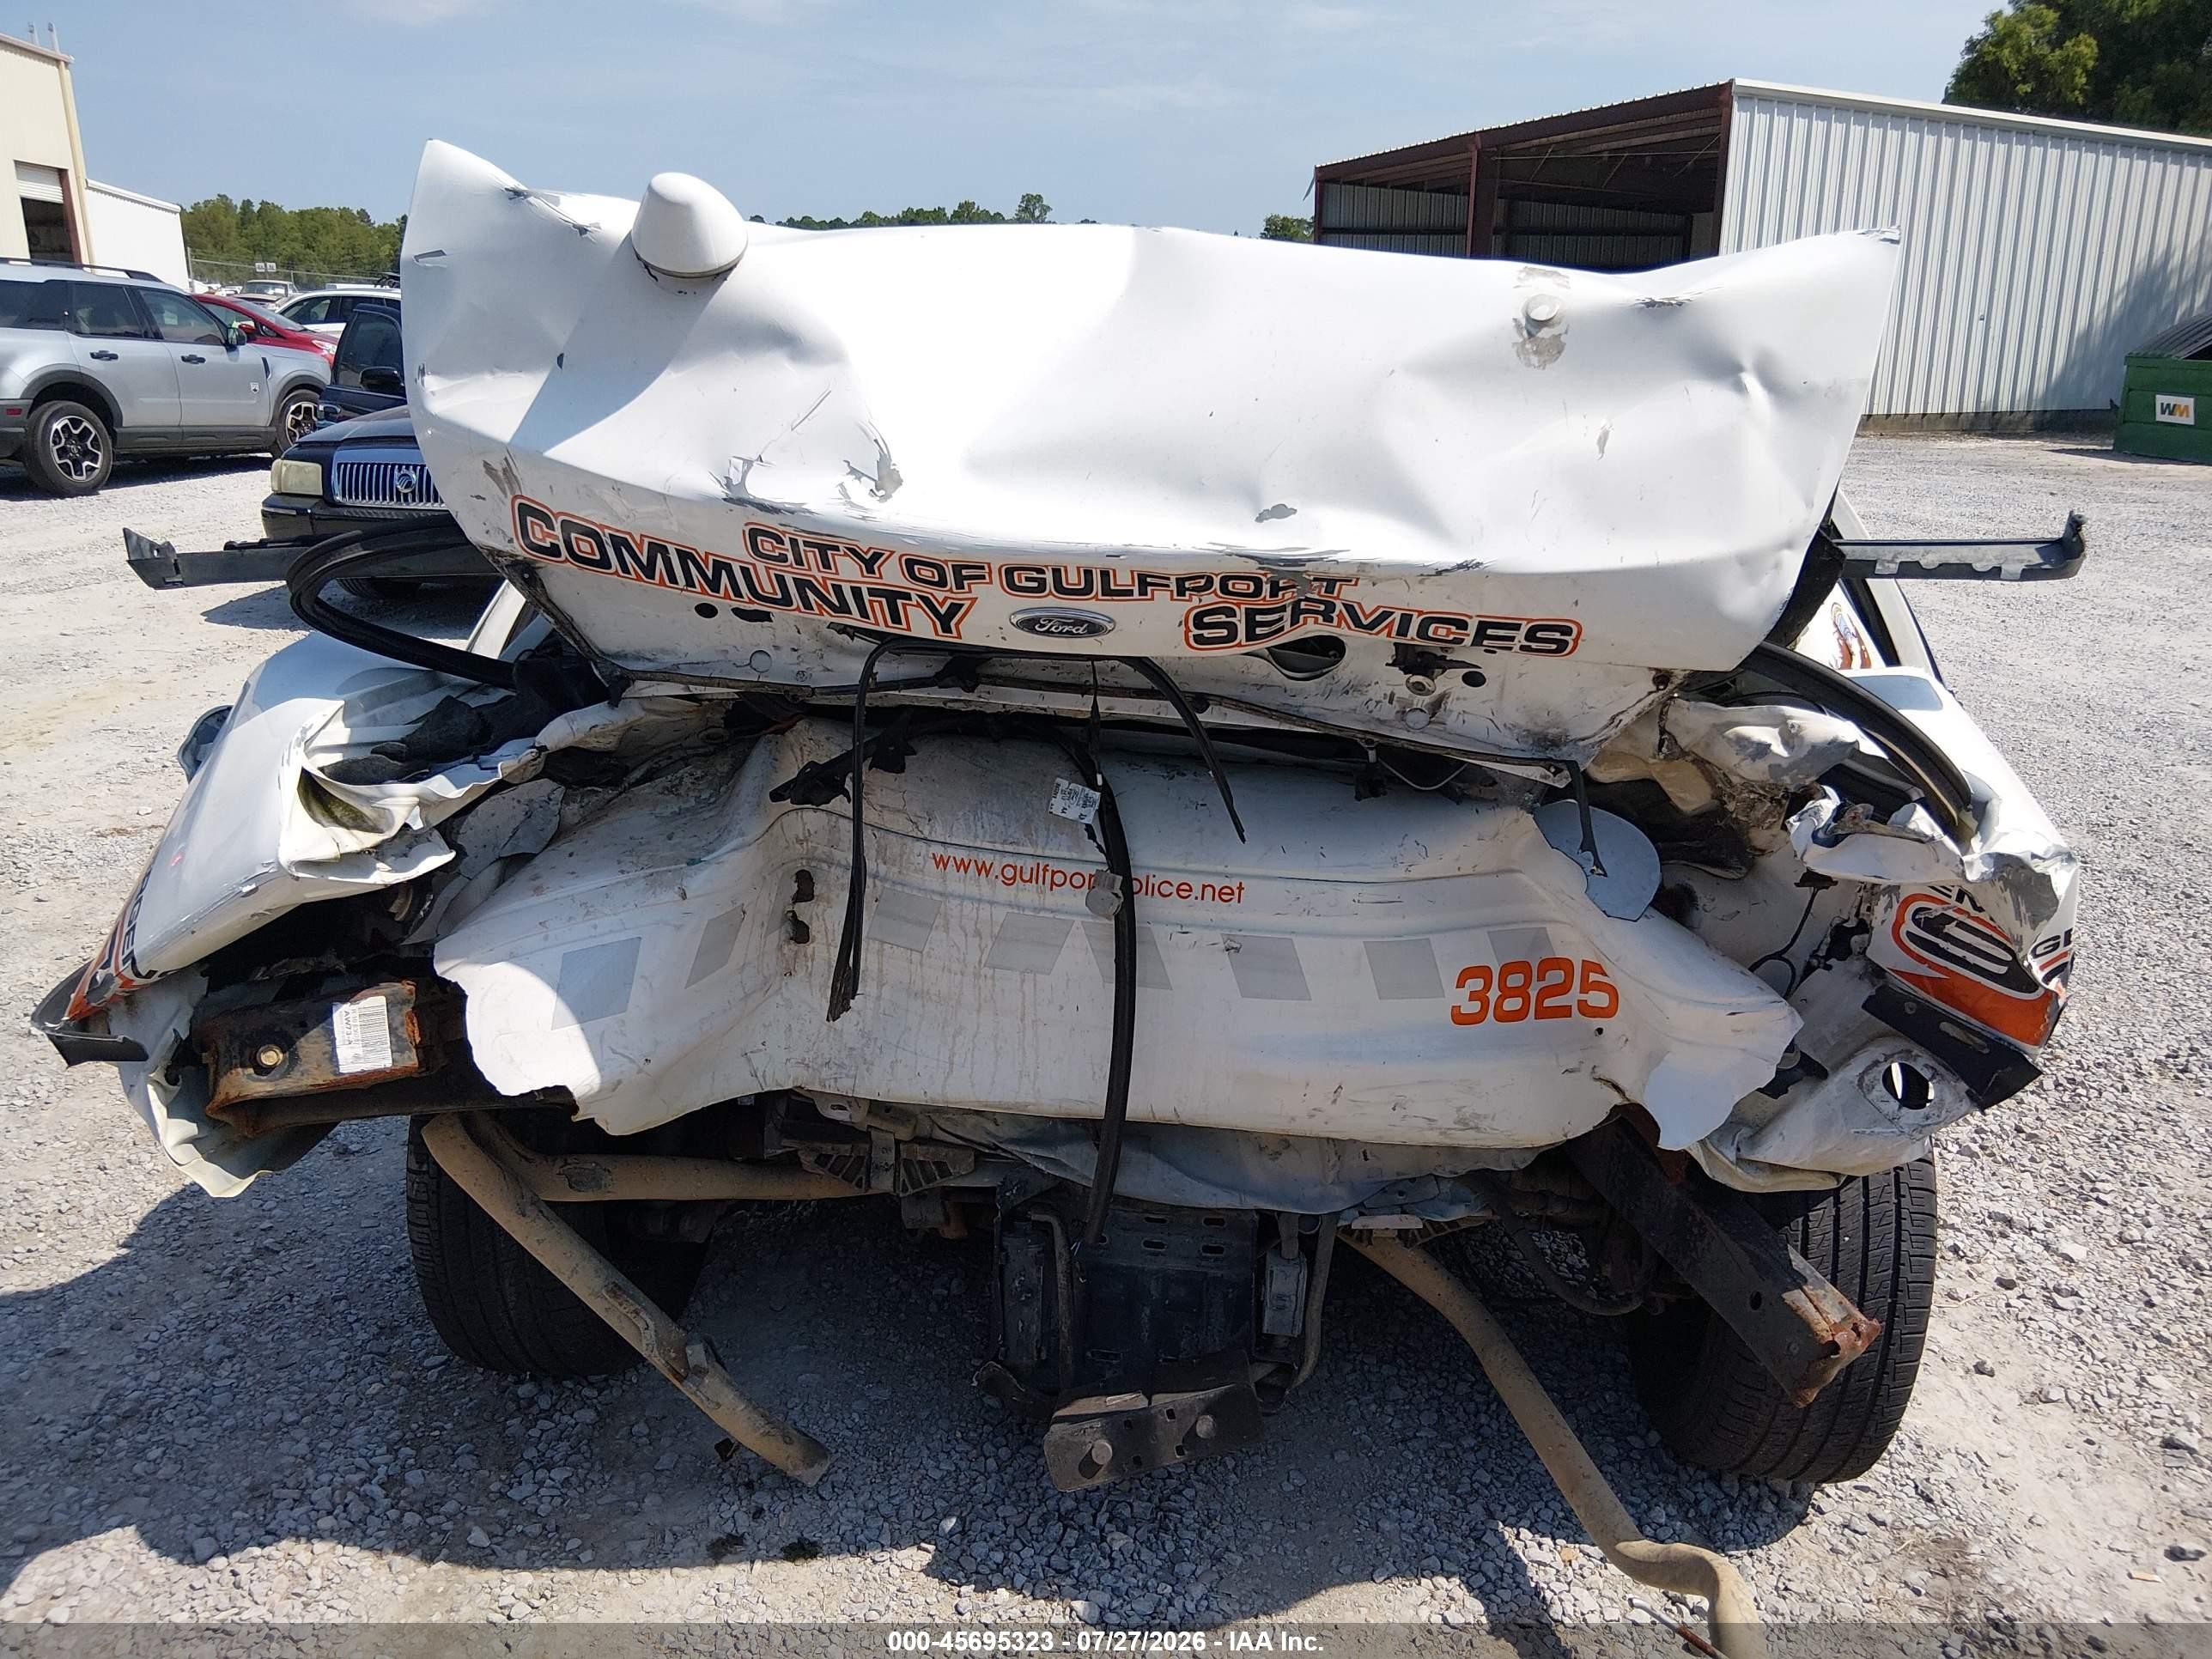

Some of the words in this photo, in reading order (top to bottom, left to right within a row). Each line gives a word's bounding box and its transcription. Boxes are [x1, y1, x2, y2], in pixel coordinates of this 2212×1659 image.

[2160, 402, 2190, 418] WM
[512, 495, 977, 639] COMMUNITY
[745, 521, 895, 579] CITY
[899, 554, 994, 594] OF
[1034, 617, 1088, 635] Ford
[1184, 597, 1583, 657] SERVICES
[1450, 957, 1620, 1026] 3825
